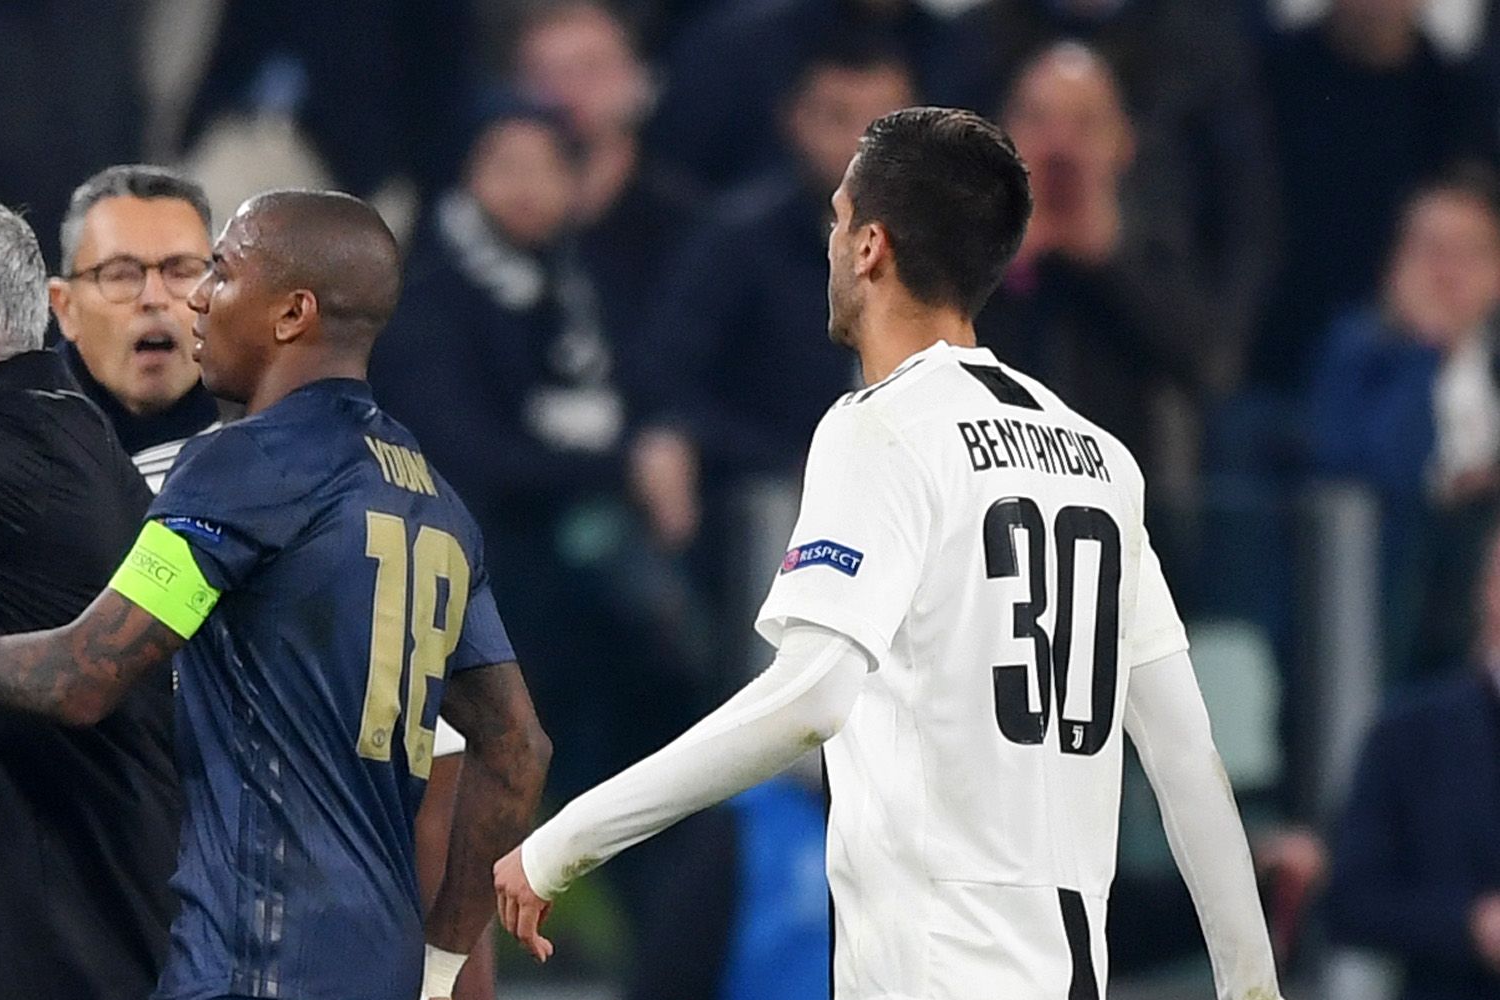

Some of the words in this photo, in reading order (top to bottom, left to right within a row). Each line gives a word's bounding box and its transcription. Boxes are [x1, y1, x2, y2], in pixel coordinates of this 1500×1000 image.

[363, 434, 440, 498] YOUN
[956, 418, 1112, 483] BENTANCUR
[799, 545, 860, 569] RESPECT
[356, 510, 470, 781] 18
[982, 495, 1123, 757] 30
